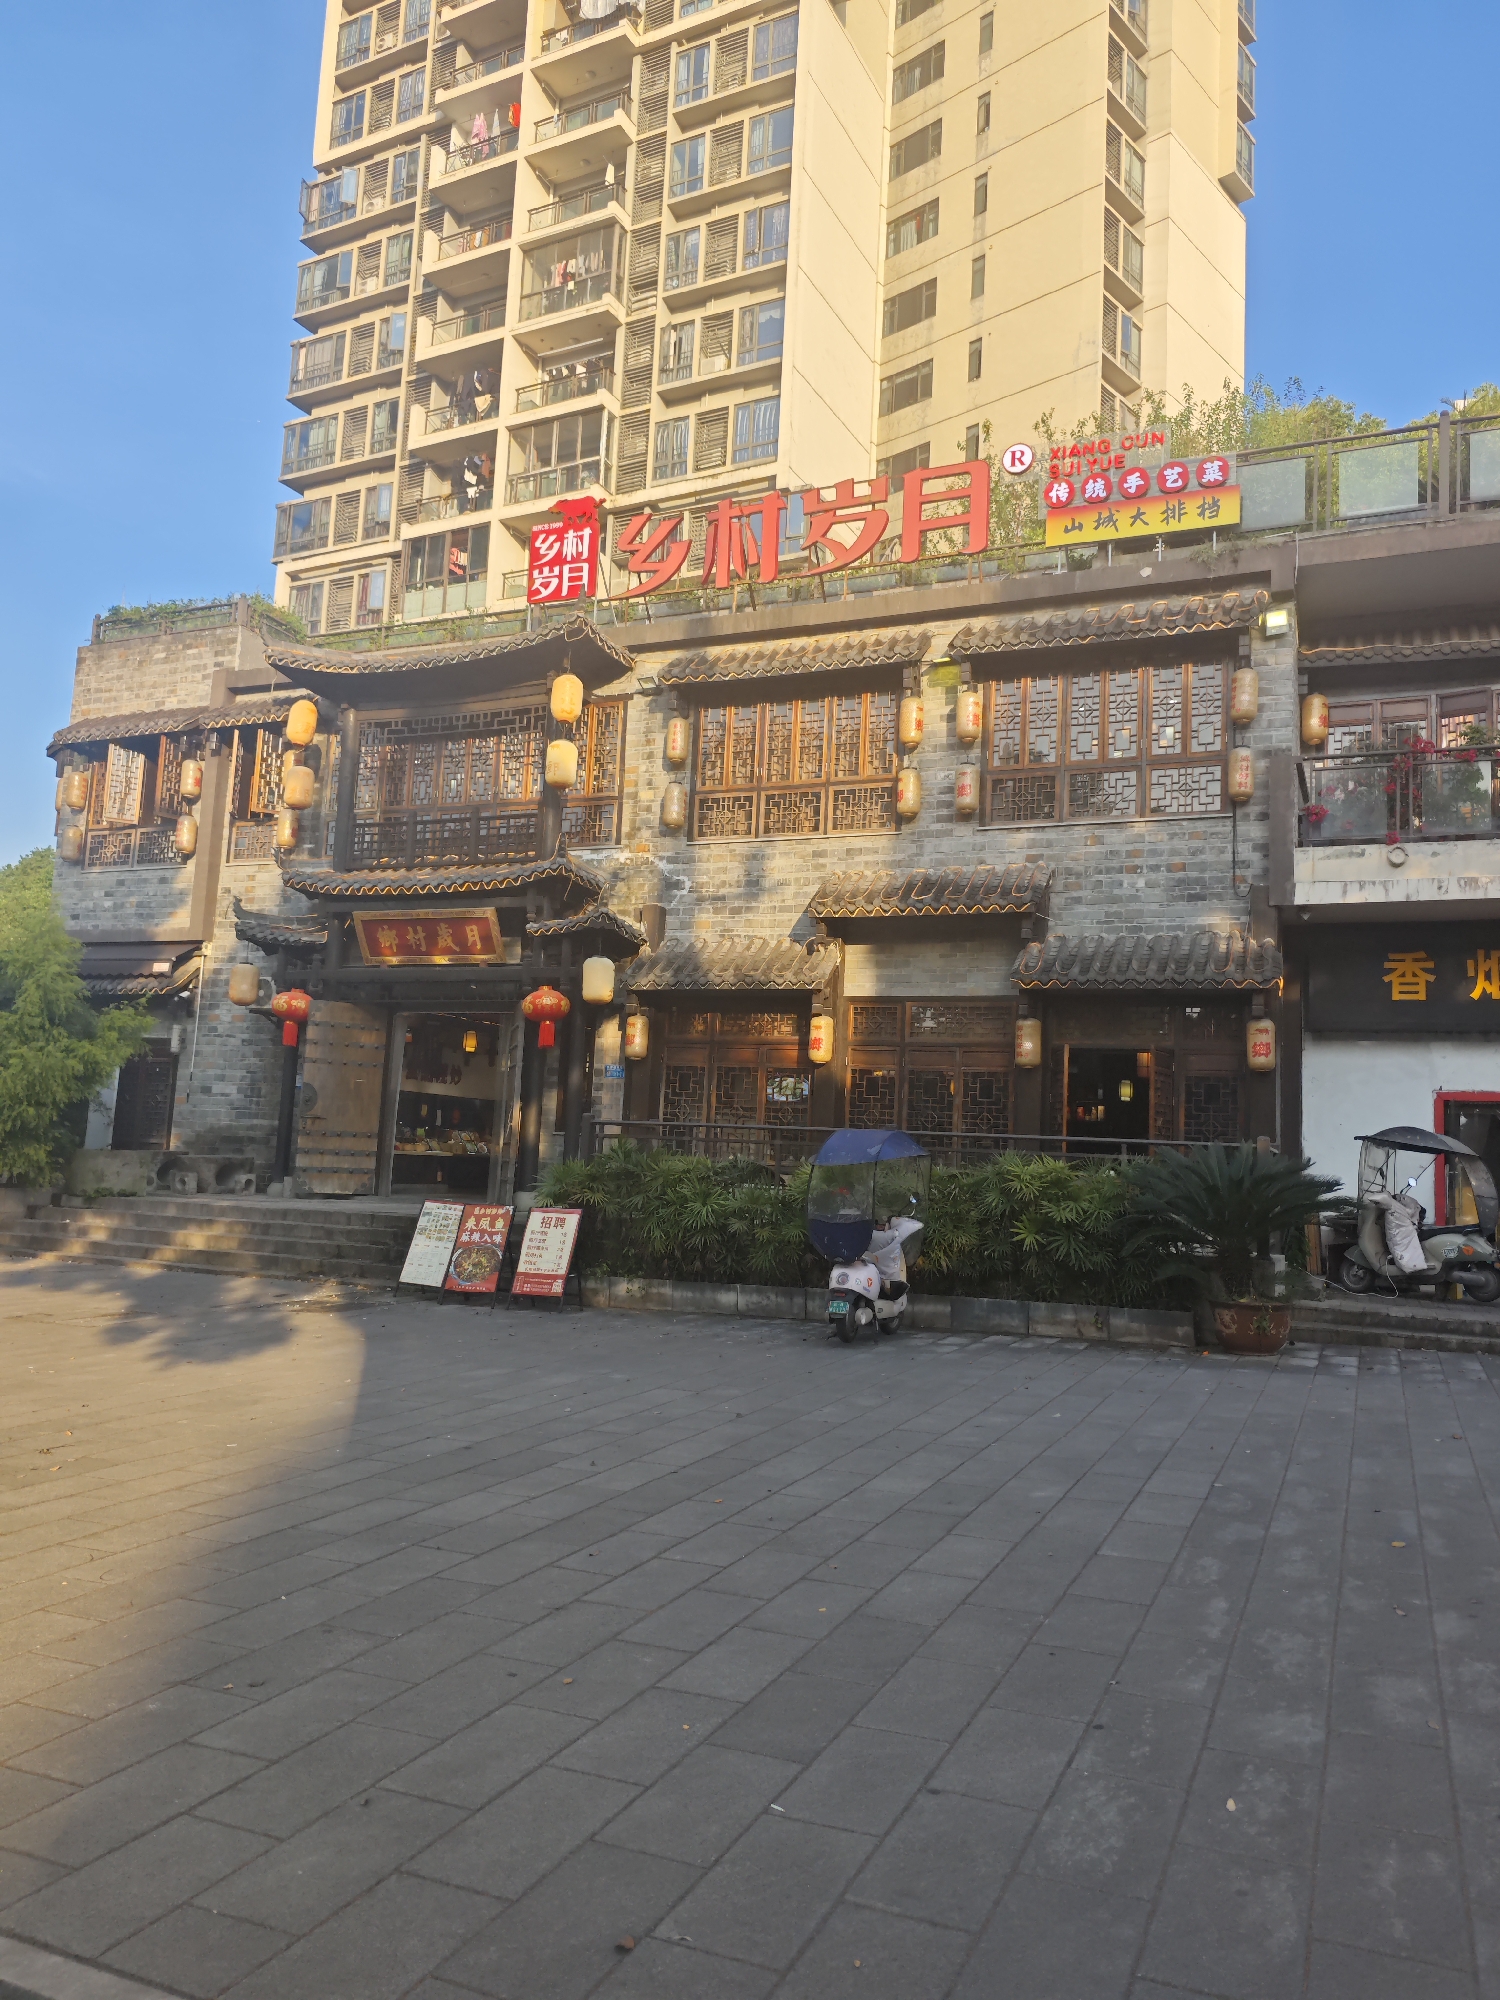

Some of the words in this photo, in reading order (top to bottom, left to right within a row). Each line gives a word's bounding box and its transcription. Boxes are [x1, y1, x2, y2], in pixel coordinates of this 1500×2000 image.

[1050, 438, 1111, 462] XIANG
[1121, 431, 1166, 450] CUN
[1048, 459, 1224, 504] 传统手艺菜
[607, 459, 991, 600] 乡村岁月
[1062, 495, 1222, 534] 山城大排档
[533, 526, 593, 566] 乡村
[531, 562, 589, 600] 岁月
[464, 1215, 506, 1231] 来凤鱼
[540, 1216, 567, 1230] 招聘
